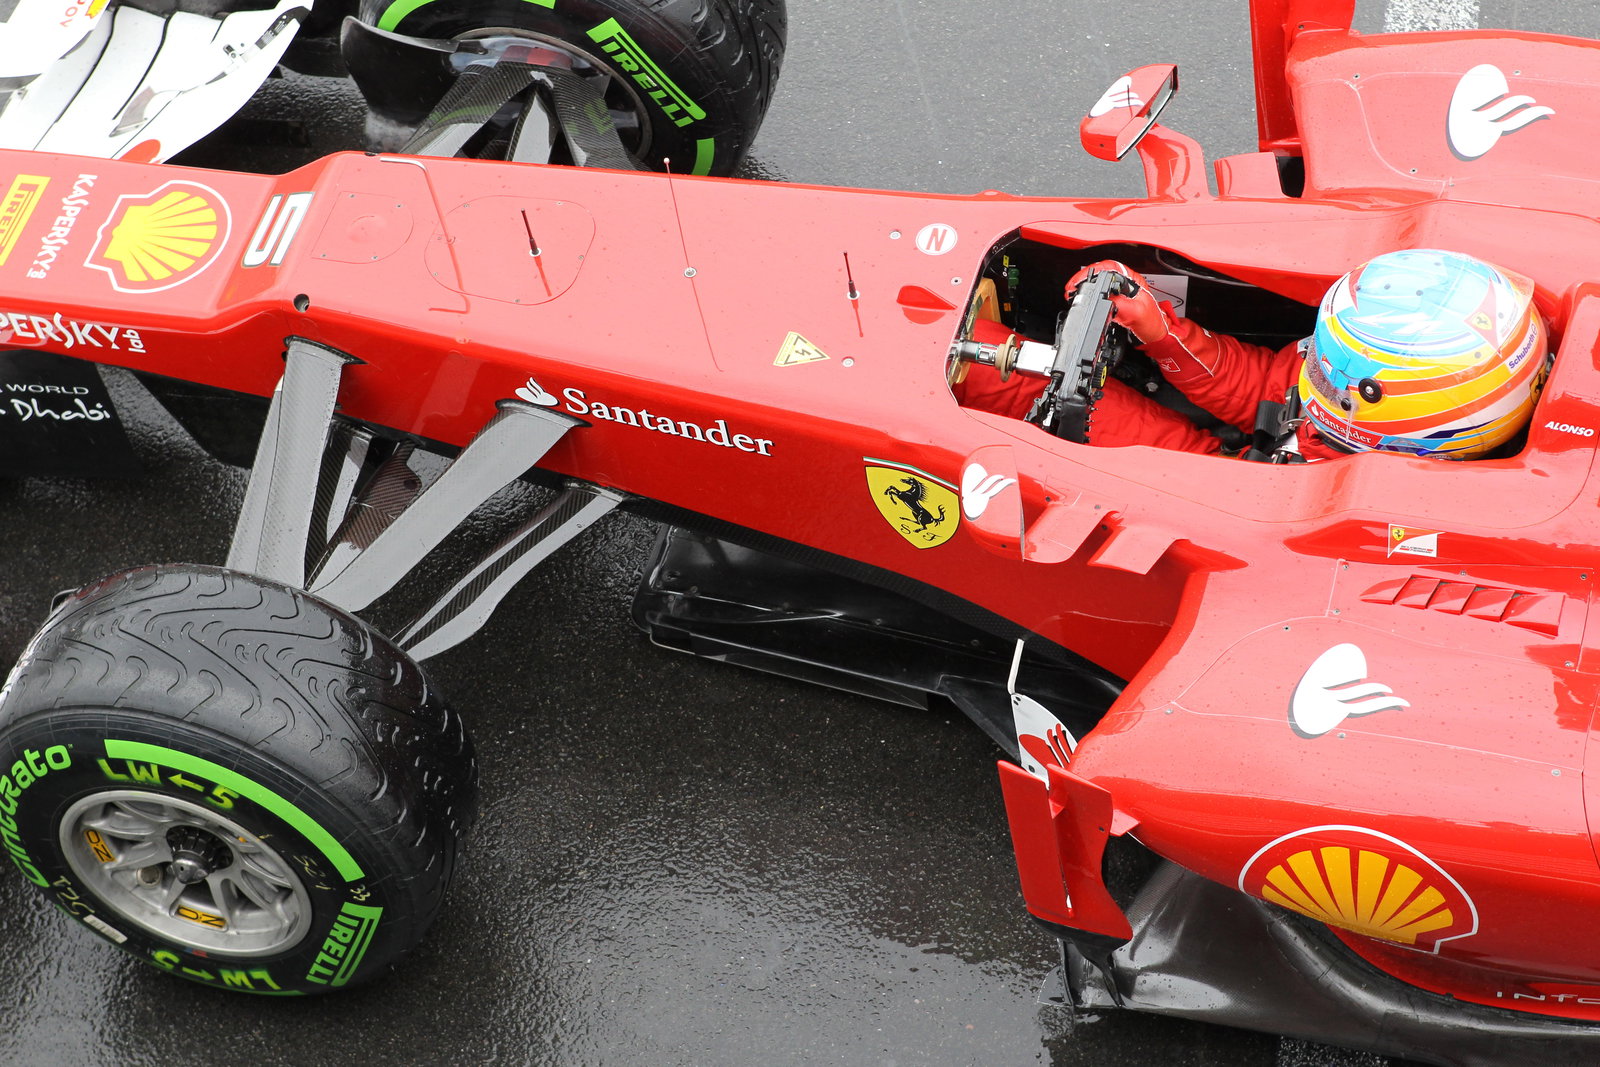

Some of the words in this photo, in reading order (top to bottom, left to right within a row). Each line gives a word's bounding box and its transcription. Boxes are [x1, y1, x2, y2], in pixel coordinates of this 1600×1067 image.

[585, 16, 707, 128] PIRELLI
[33, 174, 98, 270] KASPERSKY
[241, 190, 316, 268] 5
[925, 227, 948, 252] N
[26, 267, 47, 279] lab
[122, 328, 147, 354] lab
[1508, 333, 1536, 369] Schuberth
[5, 383, 90, 395] WORLD
[10, 398, 111, 421] Dhabi
[562, 387, 774, 457] Santander
[1319, 411, 1372, 444] Santander
[1544, 420, 1595, 437] ALONSO
[97, 758, 163, 786] LW
[205, 784, 241, 811] 5
[305, 901, 384, 987] PIRELLI
